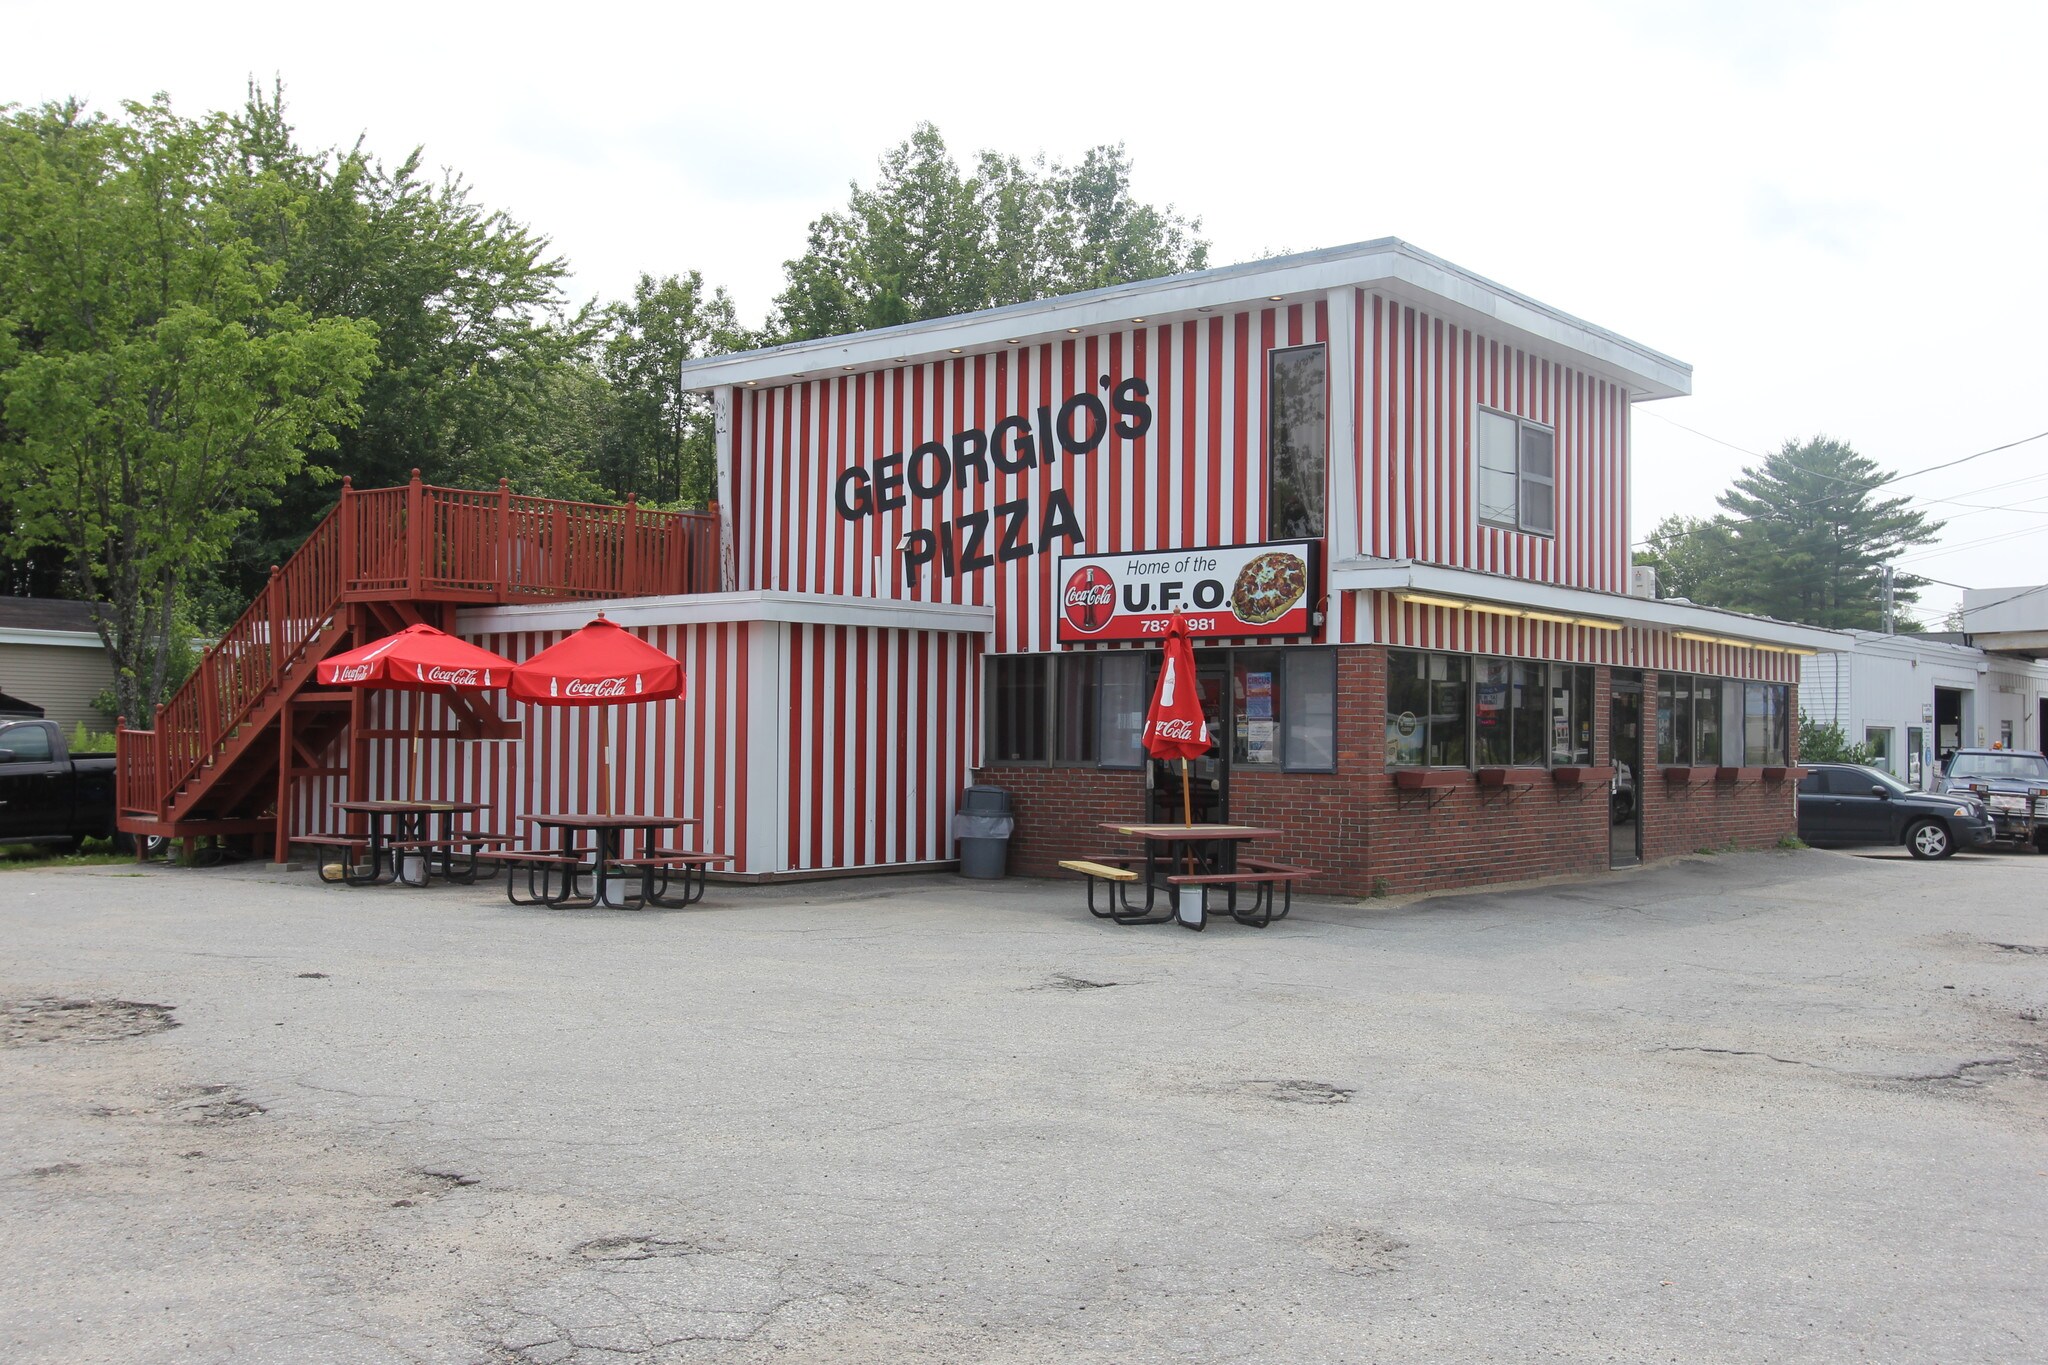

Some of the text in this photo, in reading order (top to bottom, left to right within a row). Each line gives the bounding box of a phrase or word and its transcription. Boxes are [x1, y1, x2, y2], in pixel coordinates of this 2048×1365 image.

[835, 374, 1152, 521] GEORGIO'S
[902, 488, 1085, 588] PIZZA
[1127, 556, 1217, 575] Home of the
[1065, 584, 1113, 607] Coca-Cola
[1123, 579, 1232, 613] U.F.O.
[428, 665, 479, 686] Coca-Cola
[565, 677, 628, 697] Coca-Cola
